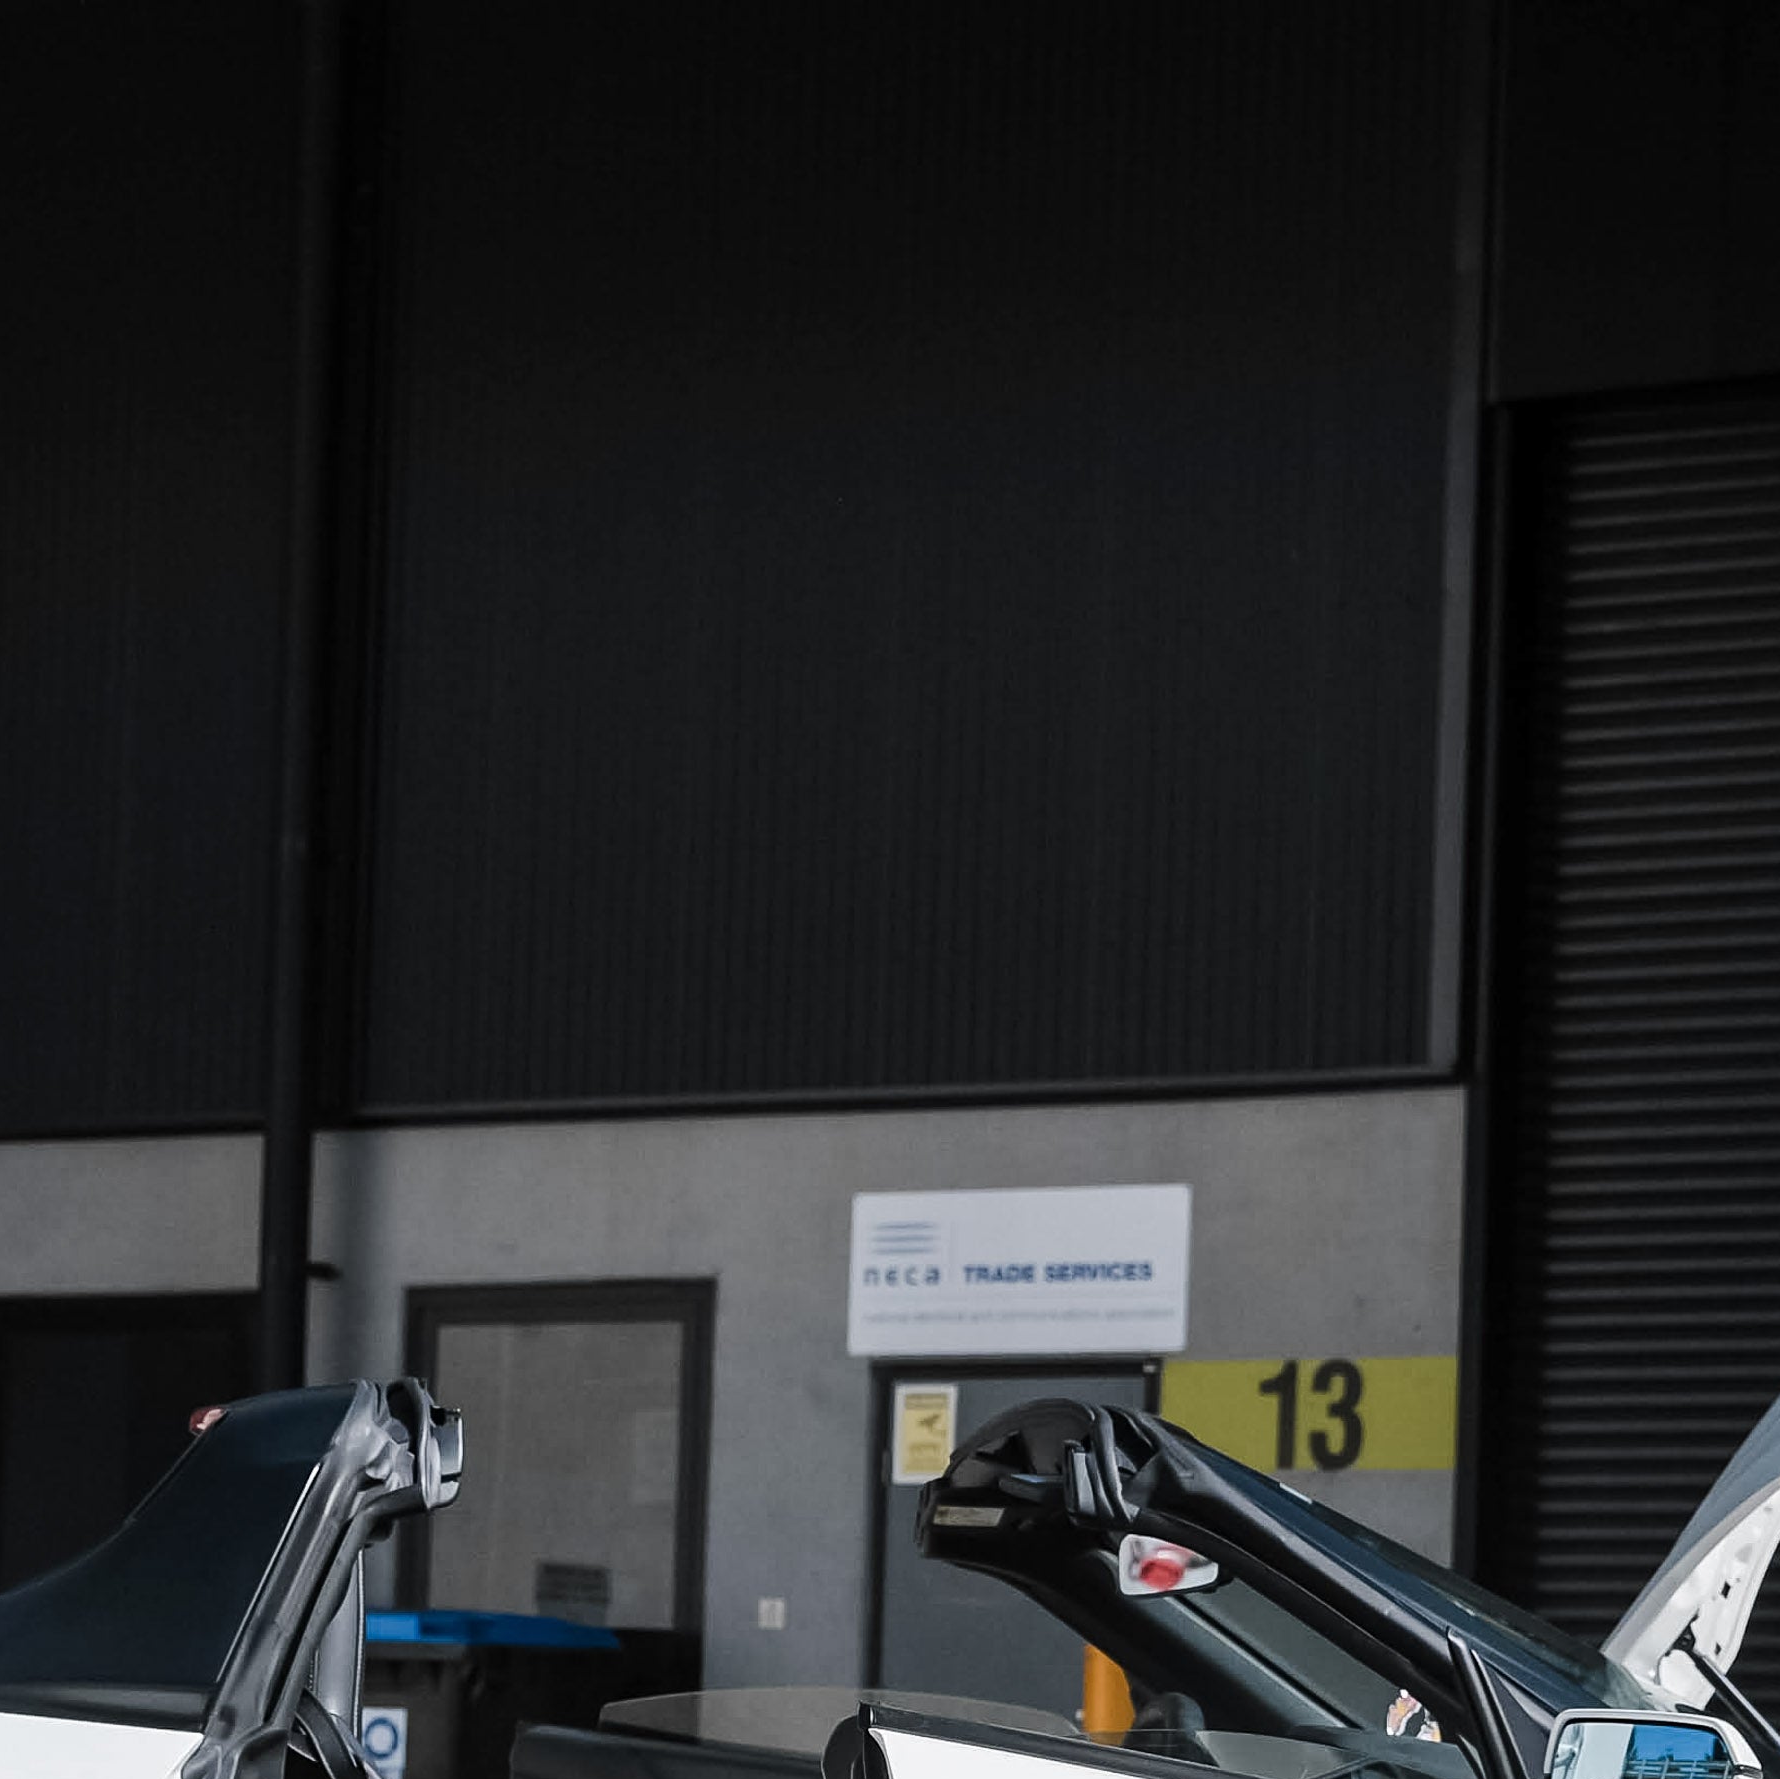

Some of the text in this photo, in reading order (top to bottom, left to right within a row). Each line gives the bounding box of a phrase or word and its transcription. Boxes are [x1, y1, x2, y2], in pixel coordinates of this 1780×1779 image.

[964, 1265, 1036, 1284] TRADE
[1045, 1262, 1153, 1282] SERVICES
[1259, 1360, 1364, 1471] 13
